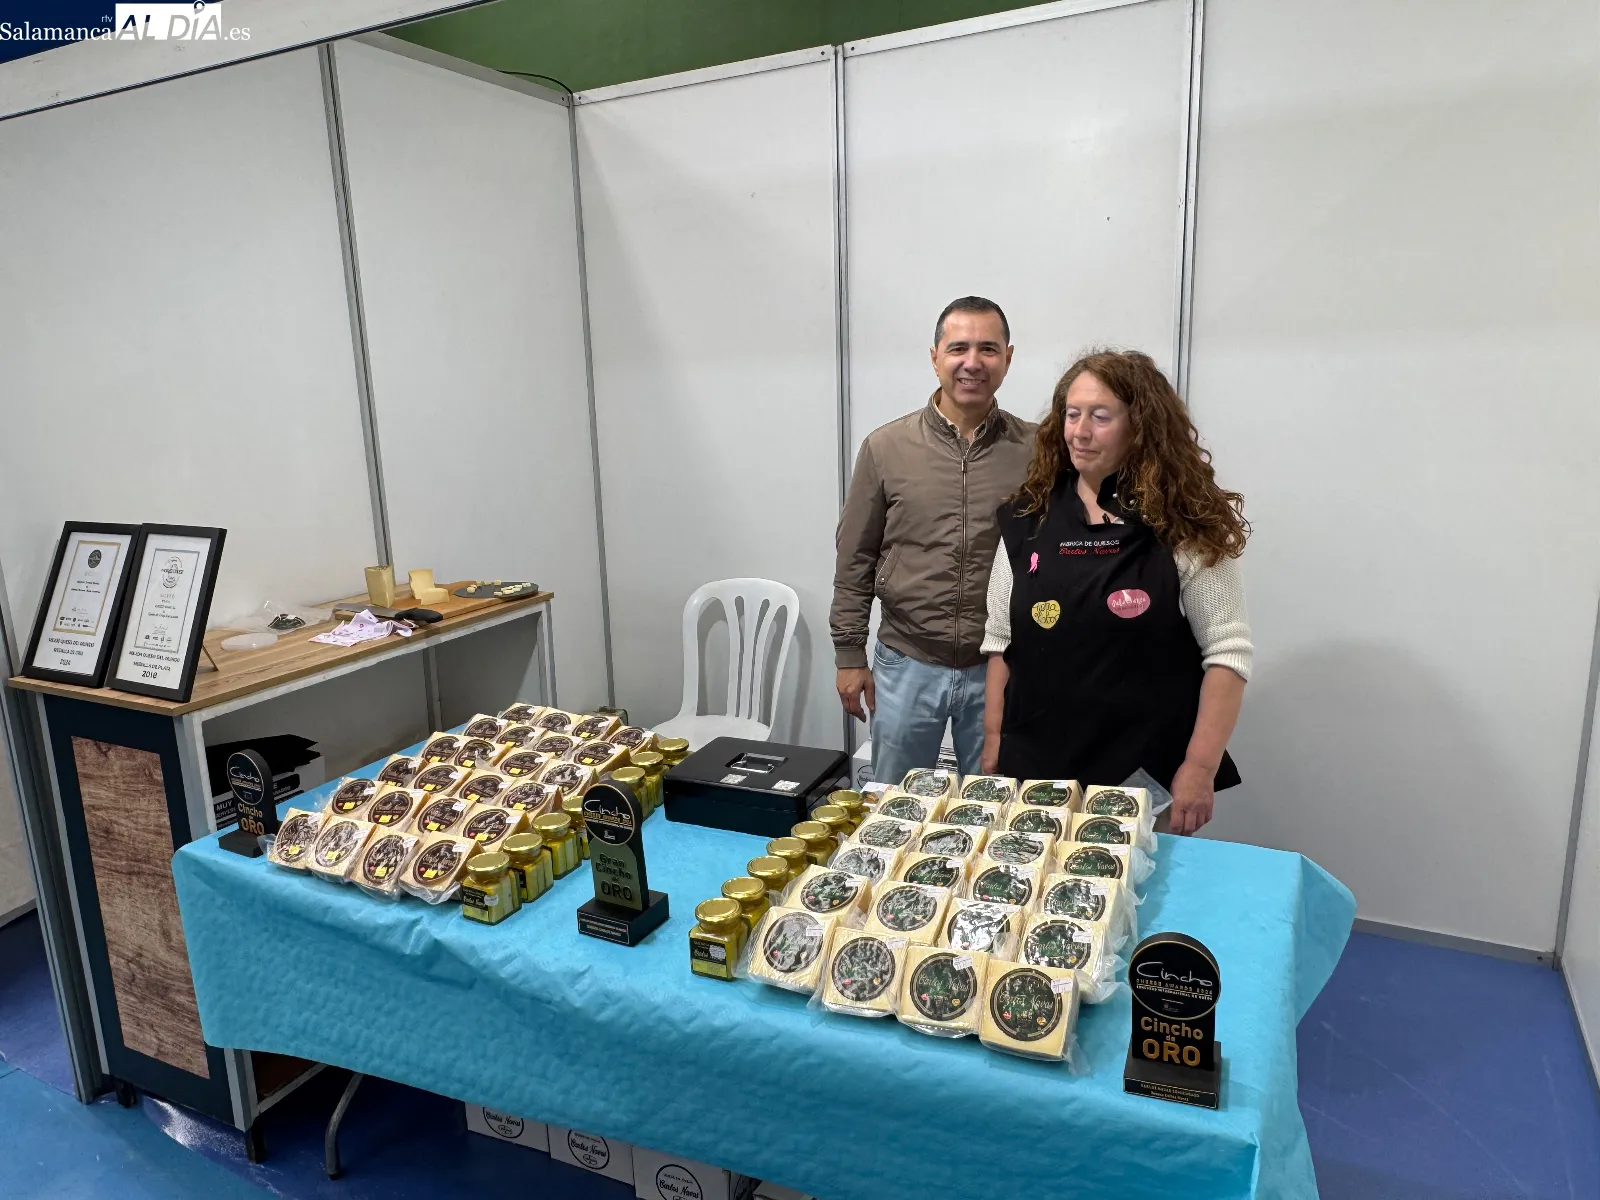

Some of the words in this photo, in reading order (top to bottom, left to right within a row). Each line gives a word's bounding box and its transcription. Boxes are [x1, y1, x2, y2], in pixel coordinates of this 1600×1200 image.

[215, 800, 233, 813] MUY
[237, 803, 263, 818] Cincho
[584, 799, 631, 820] Cincho
[239, 818, 265, 835] ORO
[600, 852, 625, 868] Gran
[595, 862, 632, 880] Cincho
[601, 880, 634, 901] ORO
[1136, 961, 1213, 987] Cincho
[1164, 983, 1193, 992] AWARDS
[1140, 1016, 1204, 1041] Cincho
[1166, 1034, 1176, 1043] de
[1142, 1037, 1201, 1067] ORO
[570, 1138, 588, 1151] Carlos
[590, 1145, 607, 1157] Navas
[660, 1179, 679, 1192] Carlos
[680, 1186, 699, 1199] Navas
